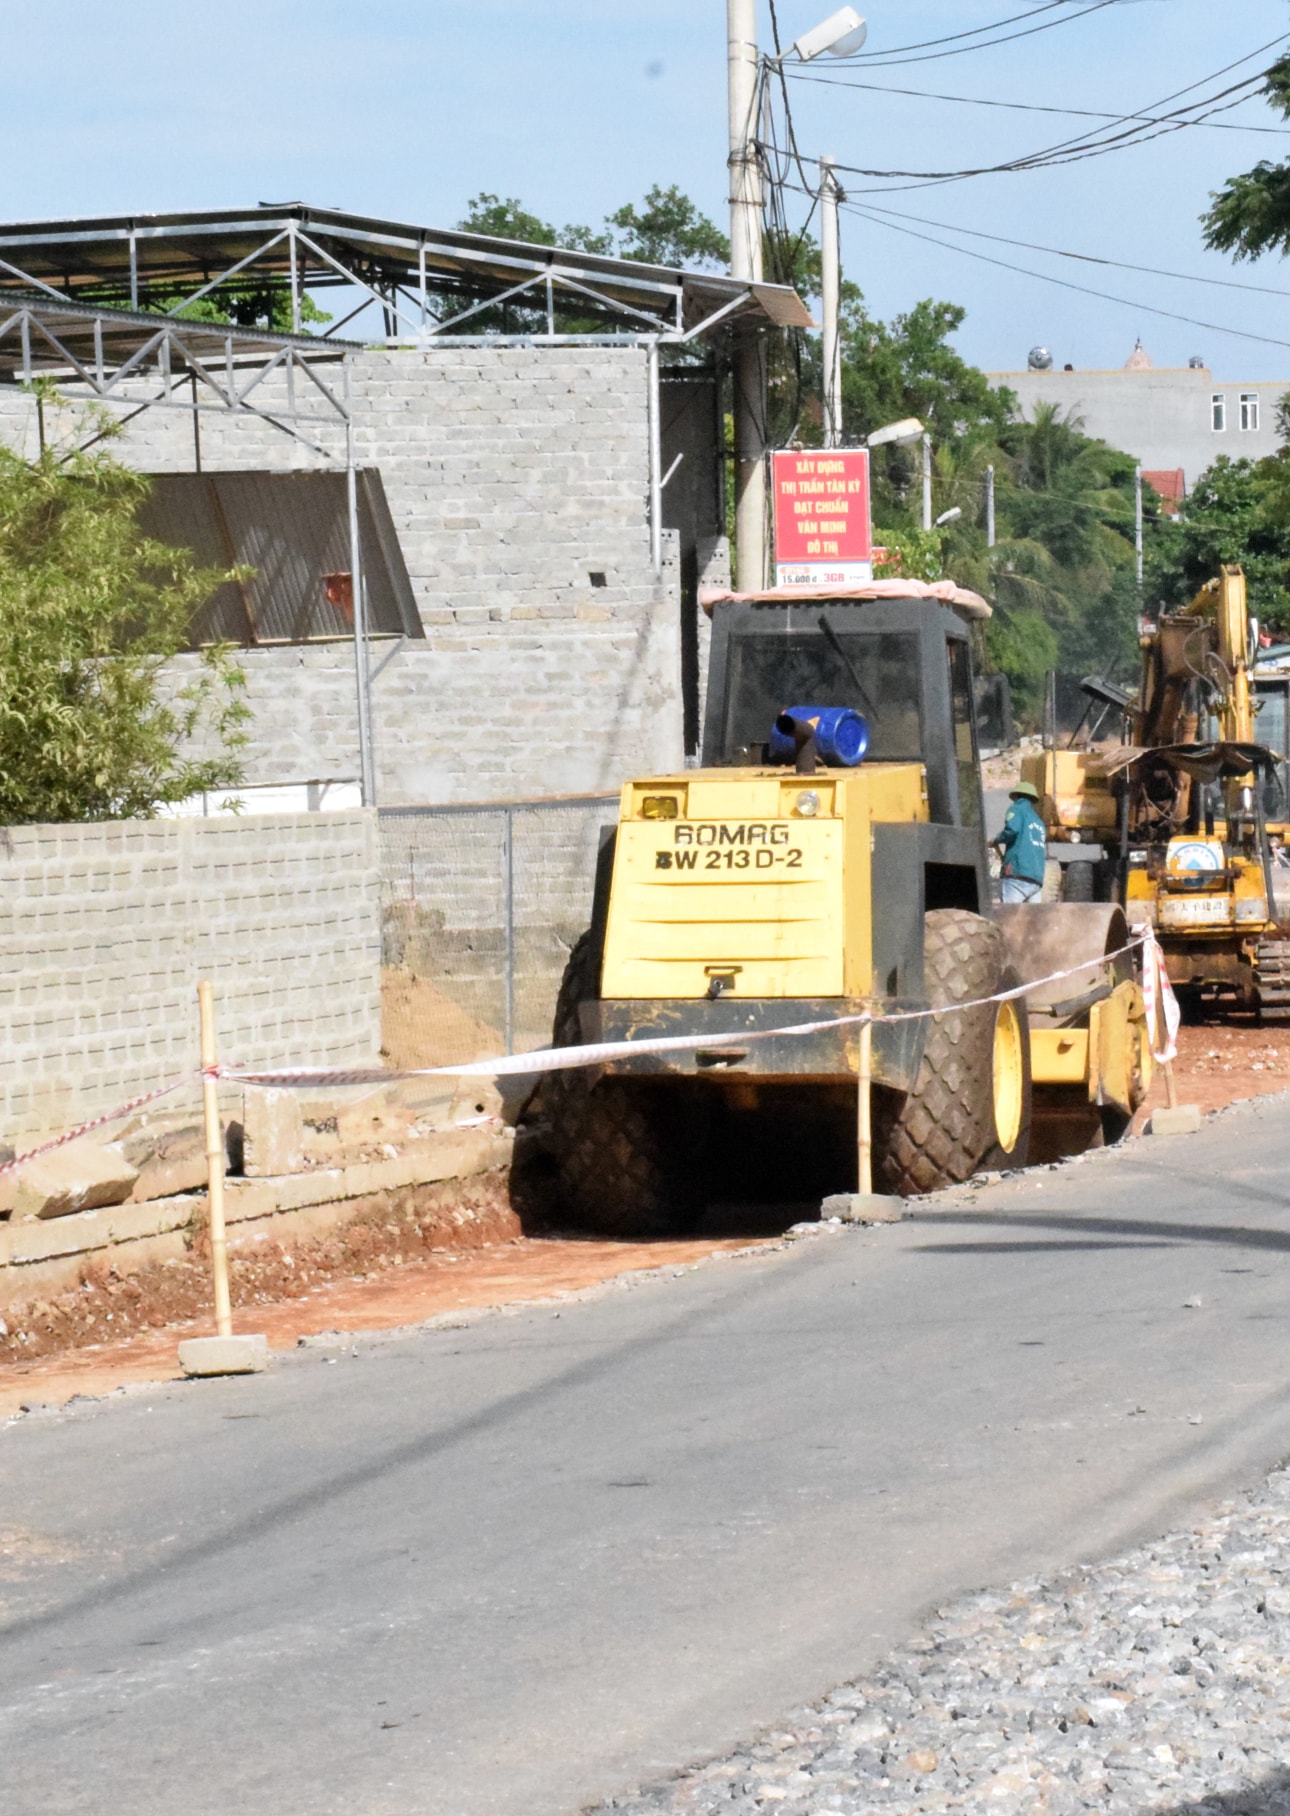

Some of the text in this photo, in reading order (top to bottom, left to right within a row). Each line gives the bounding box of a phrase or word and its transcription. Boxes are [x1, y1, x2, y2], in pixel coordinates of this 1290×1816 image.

[796, 459, 815, 474] XÂY
[781, 481, 797, 496] THỊ
[798, 477, 824, 494] TRẤN
[826, 479, 845, 493] TÂN
[820, 521, 846, 533] MINH
[822, 541, 838, 556] THỊ
[674, 824, 789, 846] BOMAG
[655, 849, 803, 870] BW 213 D-2
